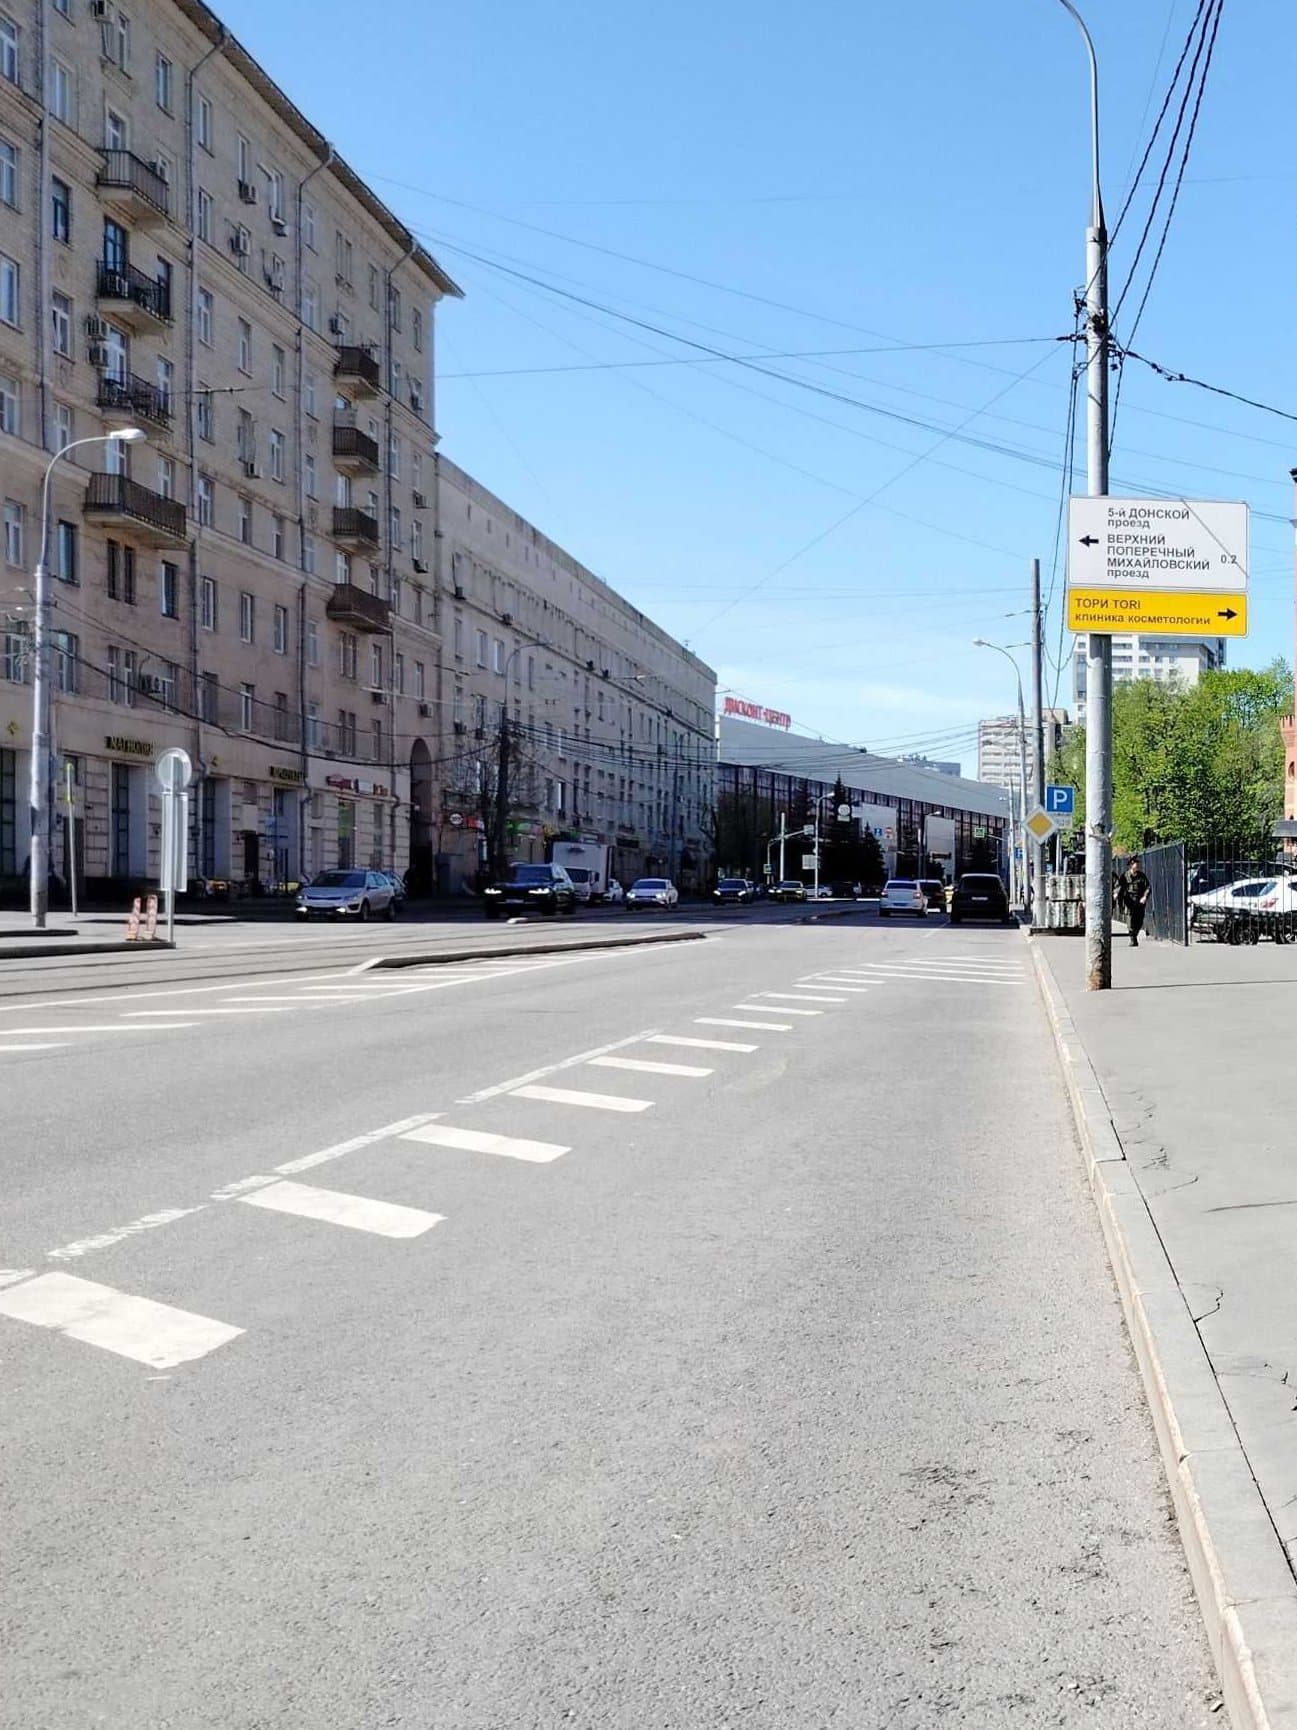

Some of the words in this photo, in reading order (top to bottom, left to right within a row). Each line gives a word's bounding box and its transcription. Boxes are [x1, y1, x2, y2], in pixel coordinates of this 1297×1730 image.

[1108, 507, 1126, 518] 5-й
[1129, 507, 1190, 520] ДОНСКОЙ
[1107, 519, 1150, 529] проезд
[1107, 533, 1166, 546] ВЕРХНИЙ
[1107, 545, 1195, 558] ПОПЕРЕЧНЫЙ
[1107, 557, 1210, 571] МИХАЙЛОВСКИЙ
[1107, 569, 1150, 579] проезд
[1076, 598, 1109, 609] ТОРИ
[1114, 599, 1141, 610] TORI
[1075, 614, 1125, 624] клиника
[1128, 615, 1211, 626] косметологии
